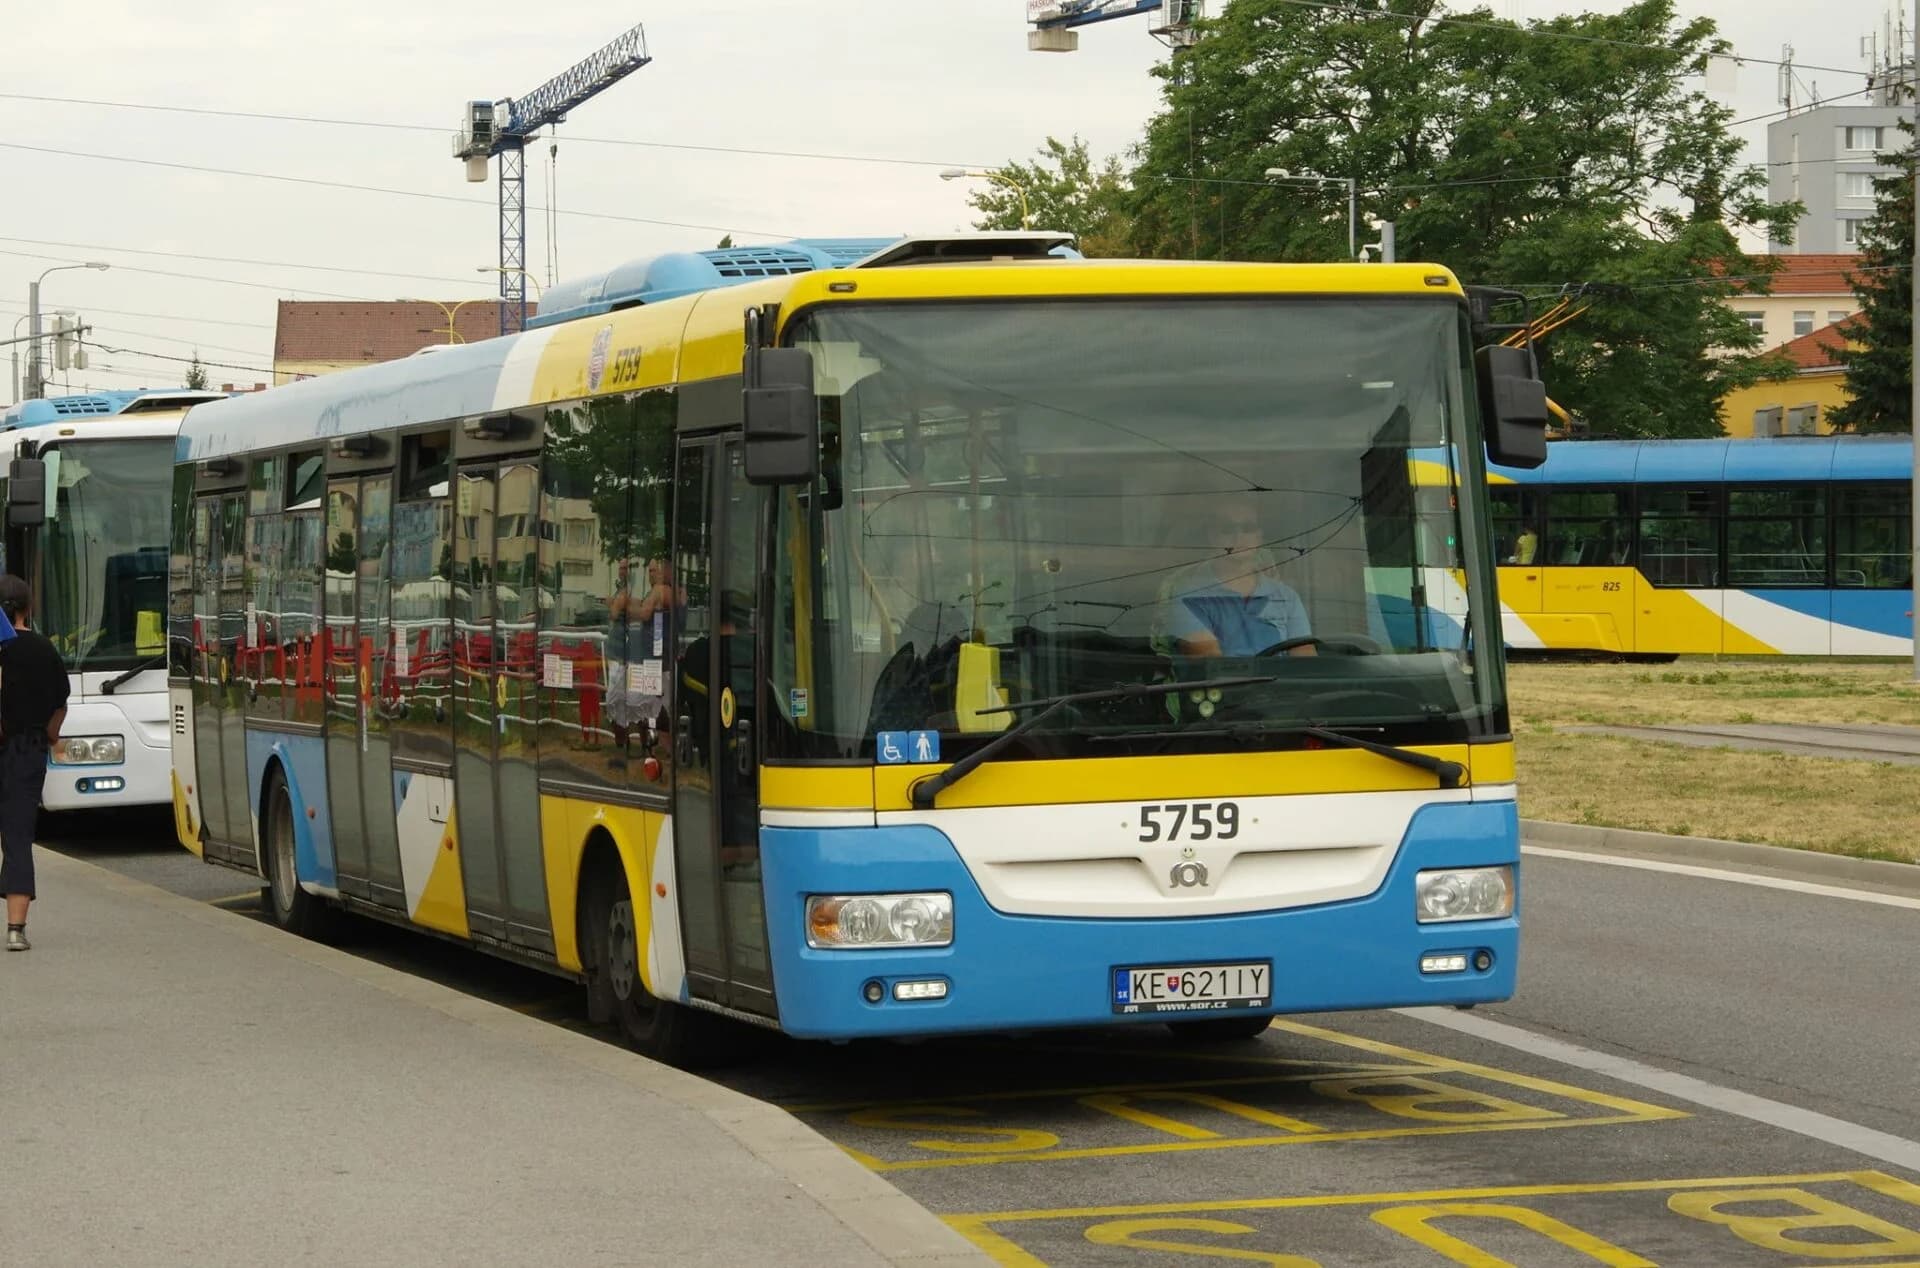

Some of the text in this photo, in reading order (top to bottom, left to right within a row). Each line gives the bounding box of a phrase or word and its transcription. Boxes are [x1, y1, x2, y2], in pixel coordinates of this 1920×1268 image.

[612, 346, 642, 384] 5759
[1602, 582, 1621, 592] 825
[1139, 802, 1239, 843] 5759
[1117, 990, 1128, 999] SK
[1133, 972, 1165, 1000] KE
[1156, 1000, 1228, 1011] www.sor.cz
